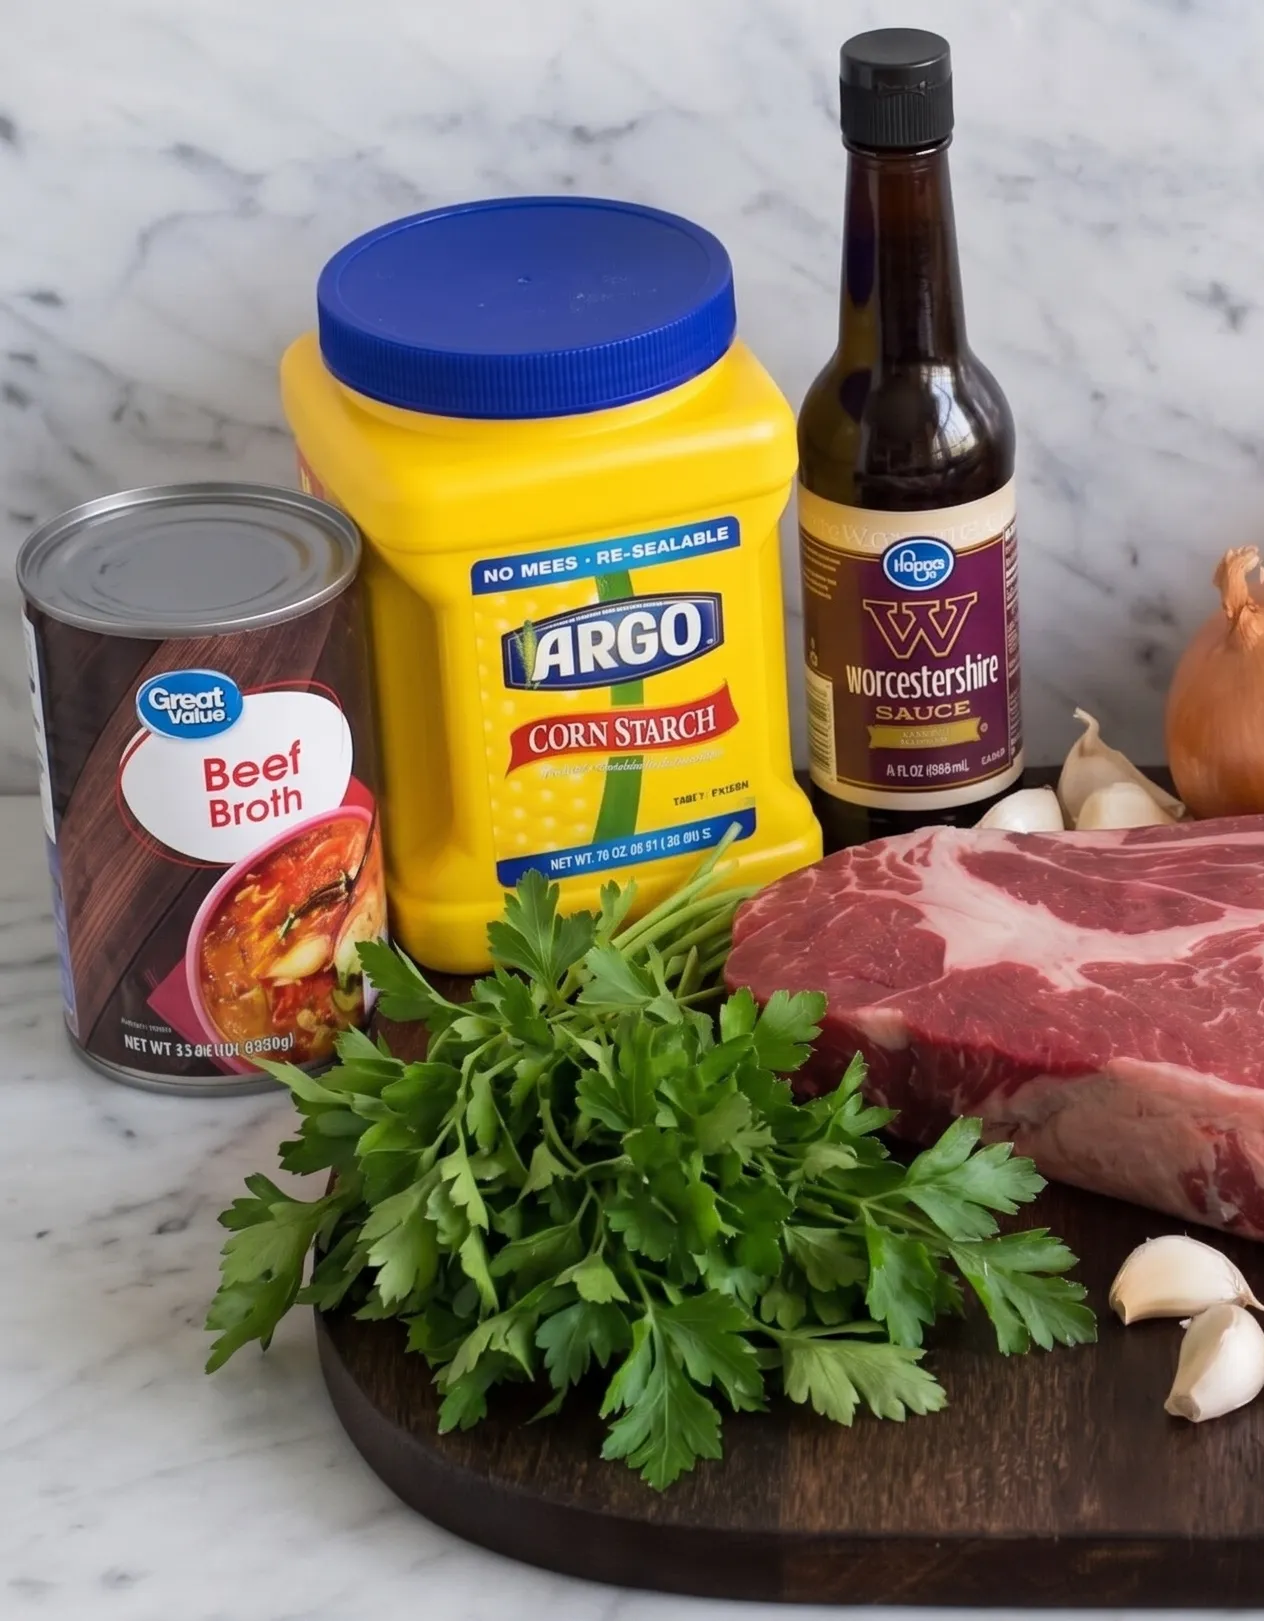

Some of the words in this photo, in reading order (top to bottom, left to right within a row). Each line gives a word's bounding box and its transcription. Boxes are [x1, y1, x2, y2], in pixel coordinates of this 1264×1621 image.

[484, 567, 514, 583] NO
[521, 556, 578, 577] MEES
[596, 526, 729, 565] RE-SEALABLE
[531, 602, 702, 682] ARGO
[863, 591, 978, 659] W
[148, 687, 225, 711] Great
[167, 708, 225, 725] Value
[875, 700, 971, 720] SAUCE
[529, 721, 608, 754] CORN
[614, 704, 717, 747] STARCH
[203, 739, 301, 792] Beef
[209, 786, 303, 828] Broth
[550, 856, 573, 871] NET
[574, 852, 595, 867] WT.
[124, 1034, 148, 1053] NET
[150, 1039, 172, 1057] WT
